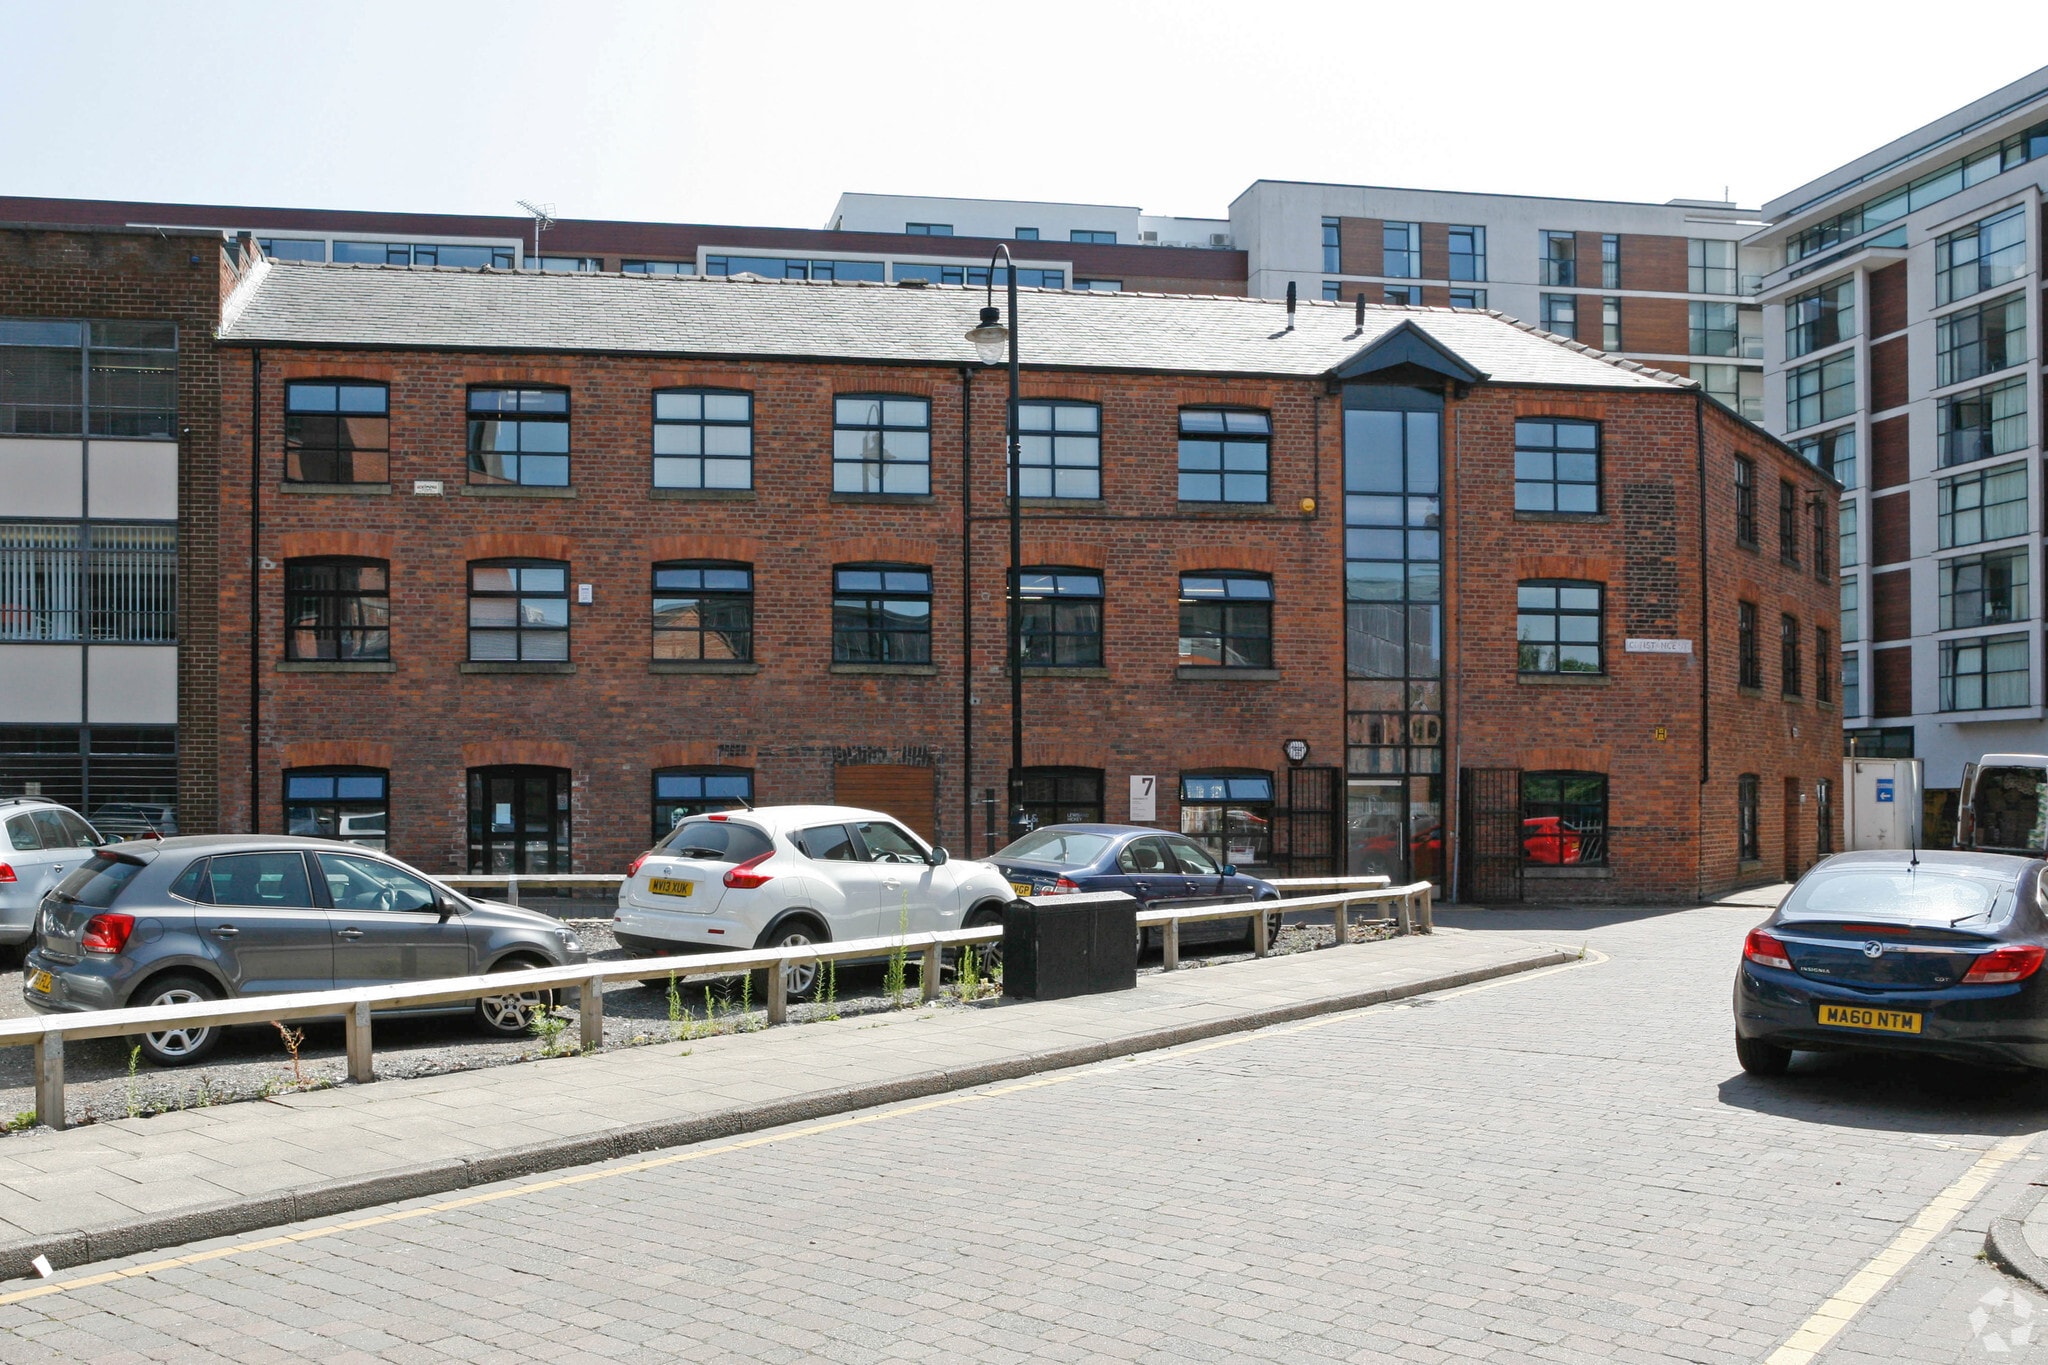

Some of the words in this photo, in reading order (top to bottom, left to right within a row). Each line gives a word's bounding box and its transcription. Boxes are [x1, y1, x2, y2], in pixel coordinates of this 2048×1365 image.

[1142, 777, 1153, 796] 7
[653, 880, 671, 892] MV13
[672, 881, 688, 894] XUK
[1014, 884, 1029, 895] VGP
[1827, 1008, 1872, 1026] MA60
[1877, 1013, 1913, 1030] NTM
